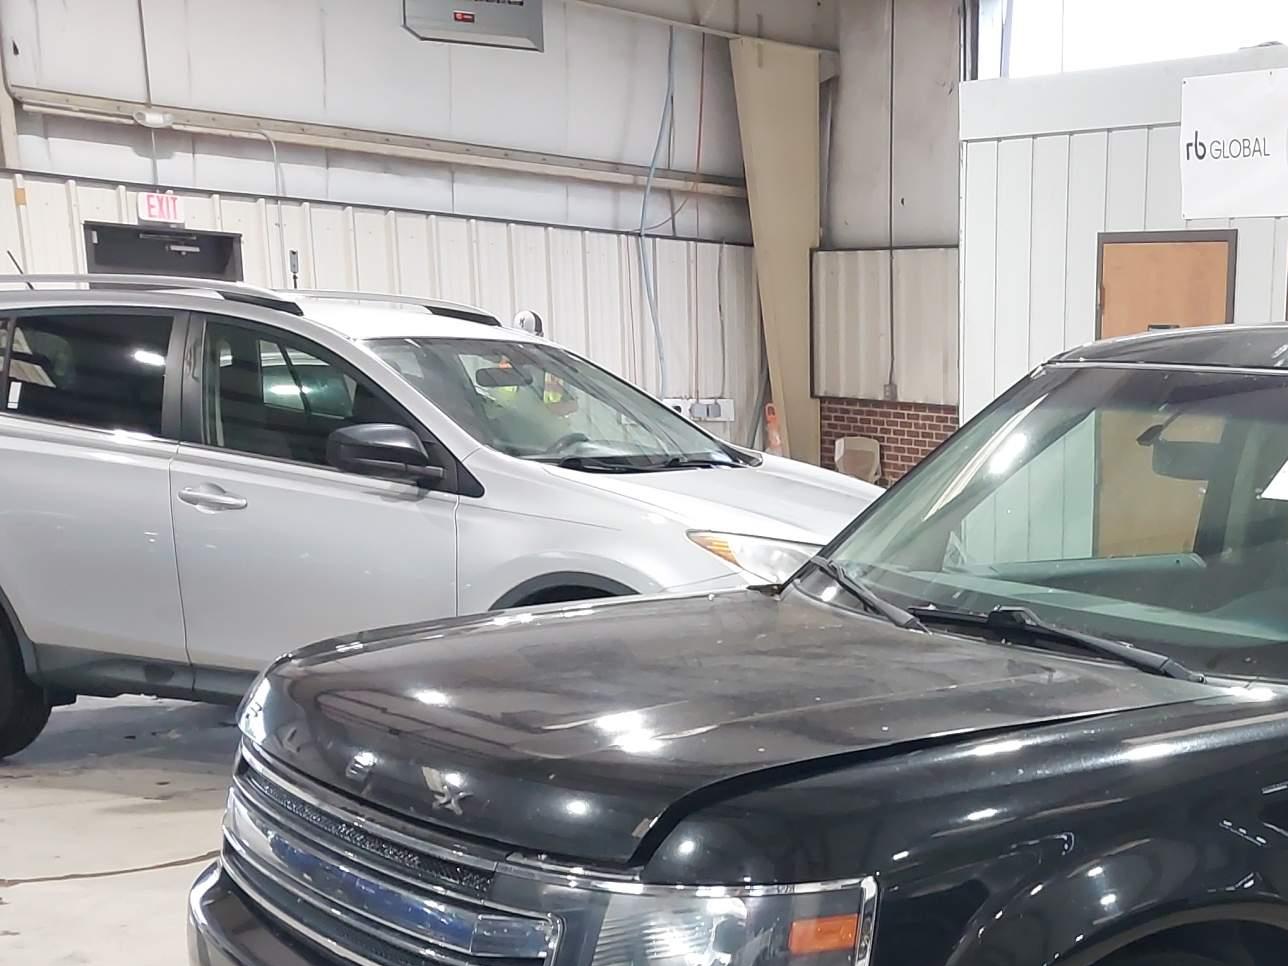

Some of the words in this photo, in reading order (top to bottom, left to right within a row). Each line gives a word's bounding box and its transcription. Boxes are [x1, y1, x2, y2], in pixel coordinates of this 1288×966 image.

[1186, 130, 1206, 160] rb
[1209, 137, 1270, 159] GLOBAL
[146, 193, 178, 219] EXIT
